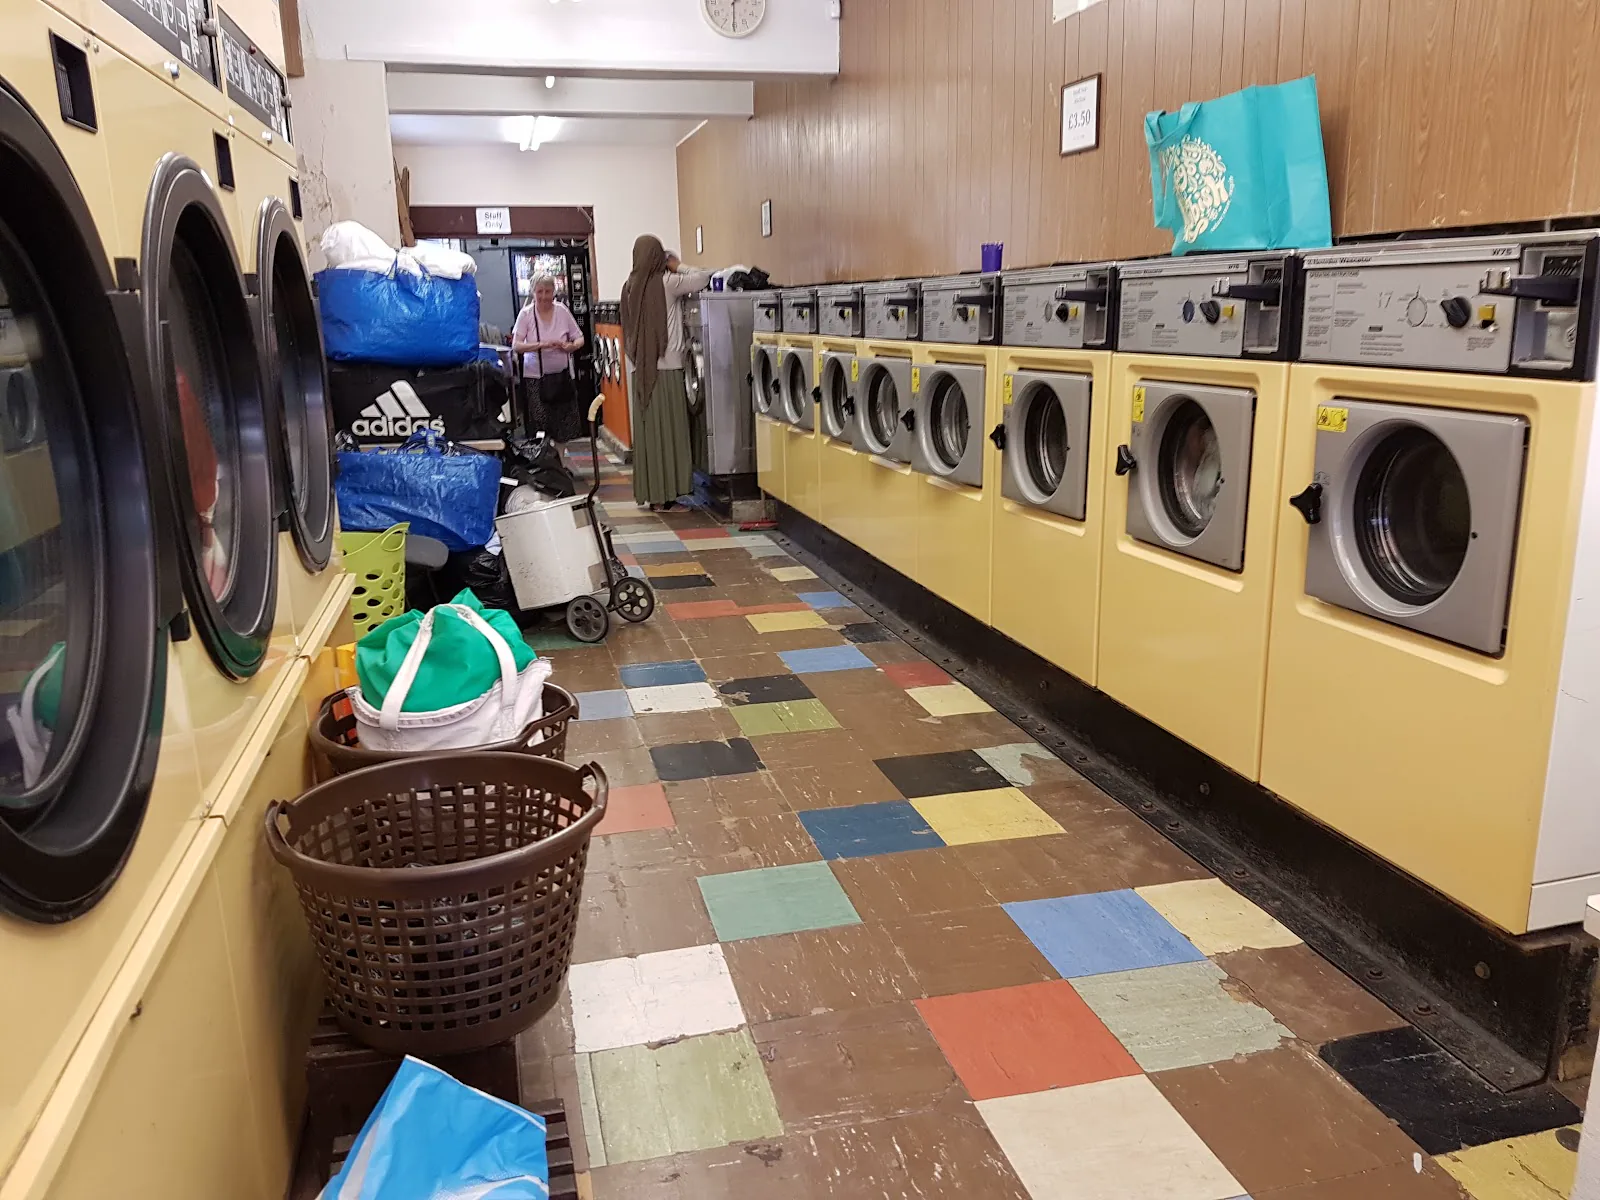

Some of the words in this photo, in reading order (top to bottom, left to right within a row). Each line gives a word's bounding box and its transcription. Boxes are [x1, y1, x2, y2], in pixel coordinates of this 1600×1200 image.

[1068, 108, 1091, 130] £3.50
[484, 211, 502, 220] Staff
[485, 220, 503, 230] Only
[351, 414, 446, 437] adidas
